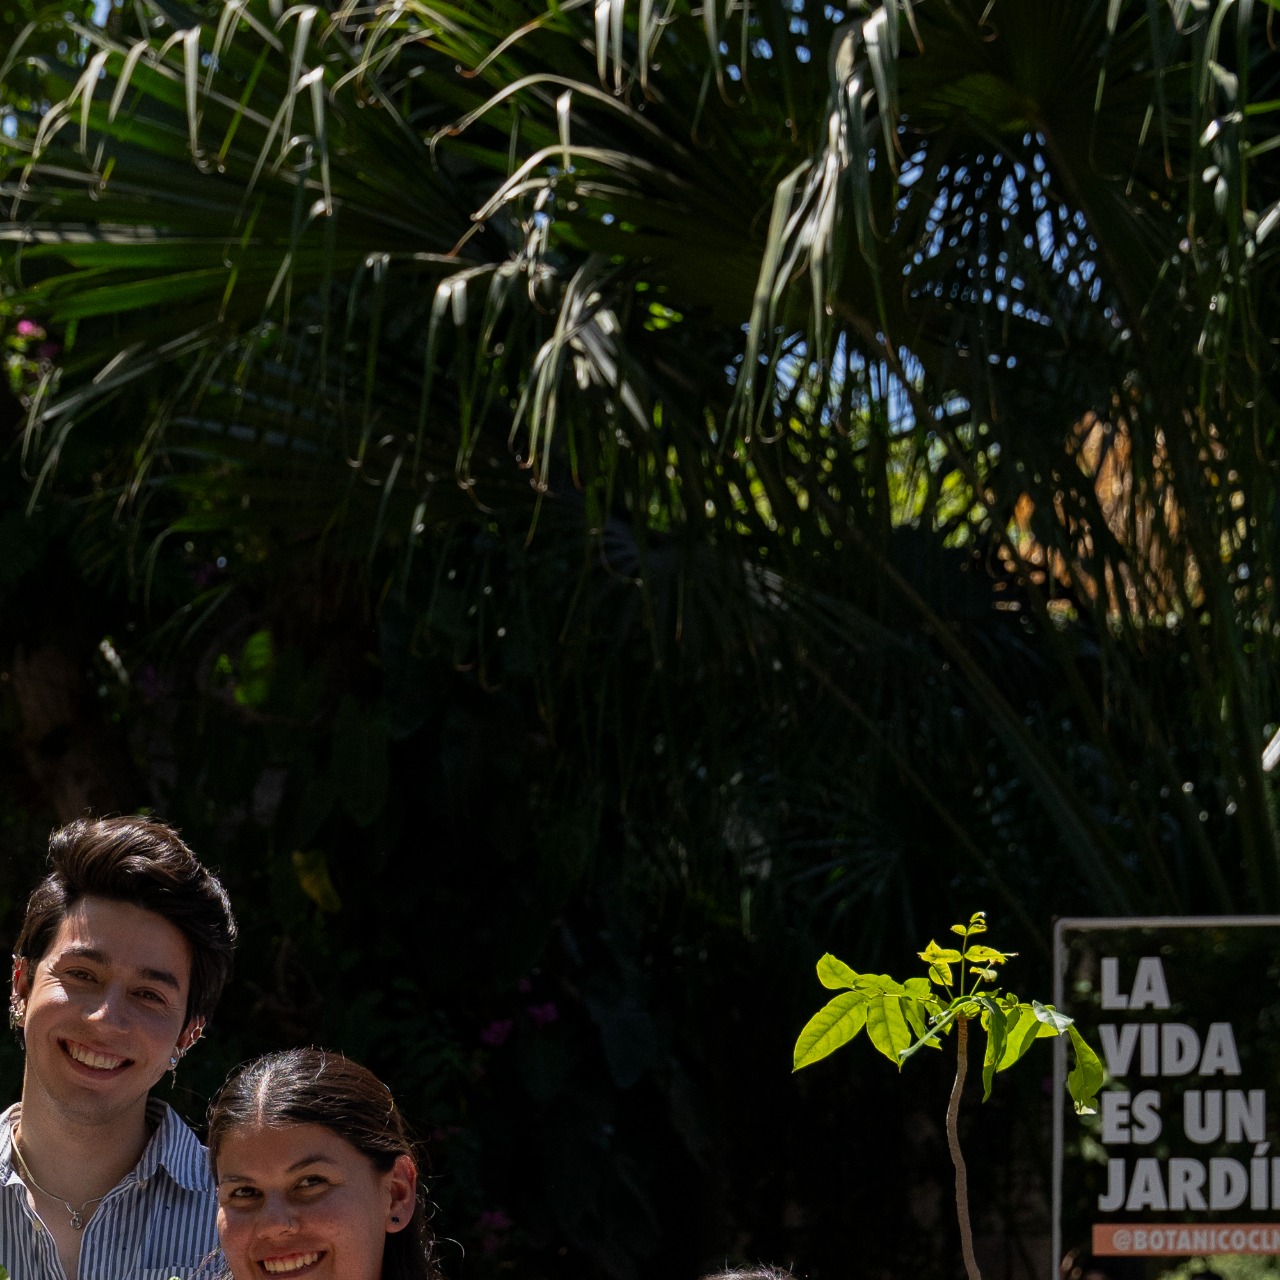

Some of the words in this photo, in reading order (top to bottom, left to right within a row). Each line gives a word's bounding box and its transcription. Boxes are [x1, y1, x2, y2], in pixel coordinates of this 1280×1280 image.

[1101, 957, 1171, 1010] LA
[1098, 1022, 1241, 1077] VIDA
[1101, 1090, 1162, 1144] ES
[1184, 1090, 1266, 1144] UN
